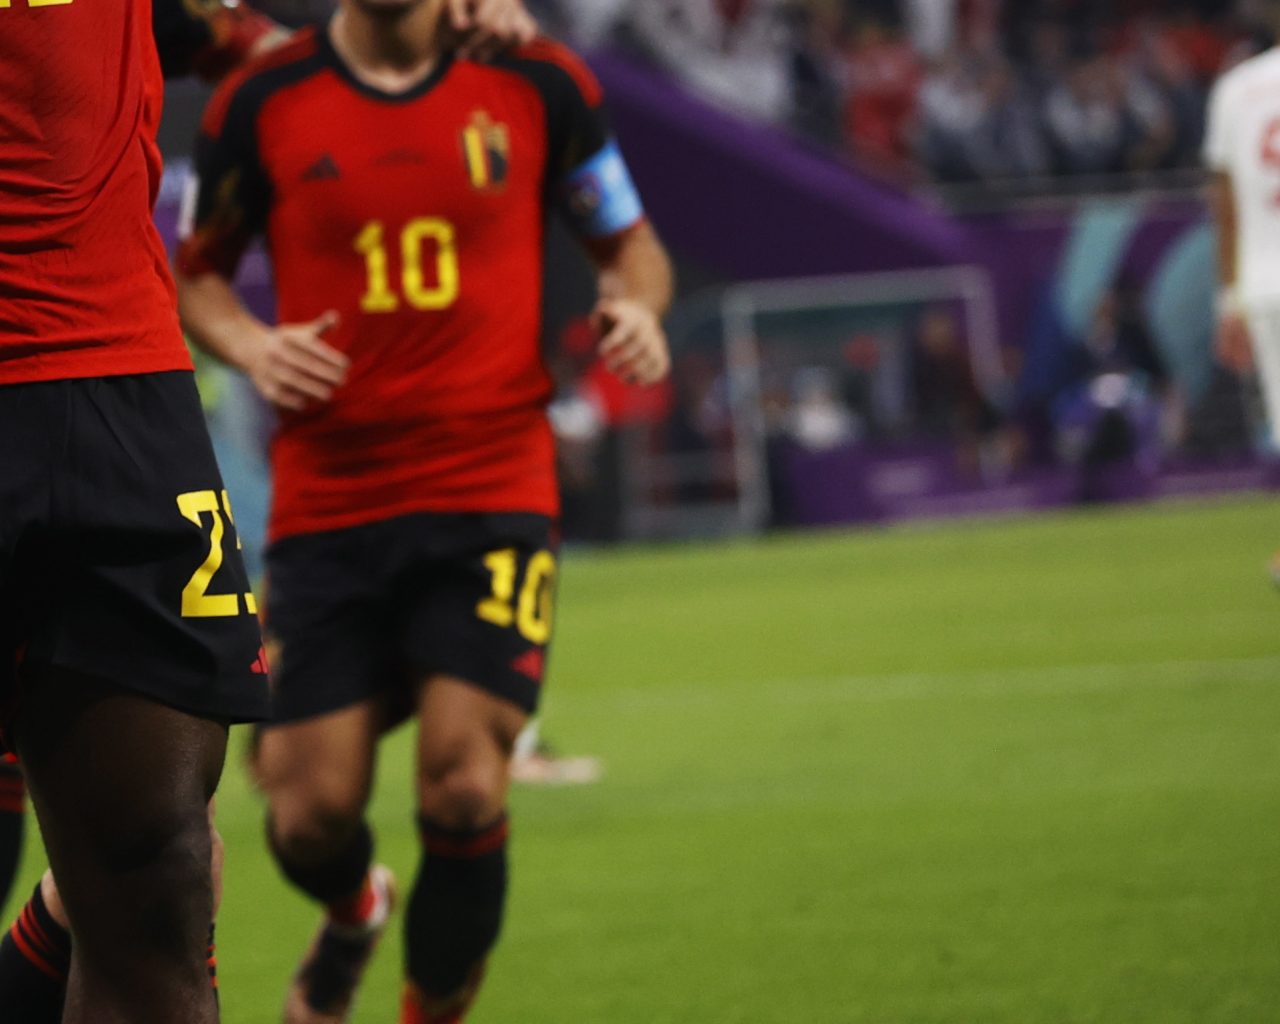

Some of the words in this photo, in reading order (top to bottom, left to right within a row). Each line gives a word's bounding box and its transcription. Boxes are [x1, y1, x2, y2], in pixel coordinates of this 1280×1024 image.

[354, 217, 459, 312] 10
[176, 489, 258, 617] 2
[476, 548, 555, 645] 10
